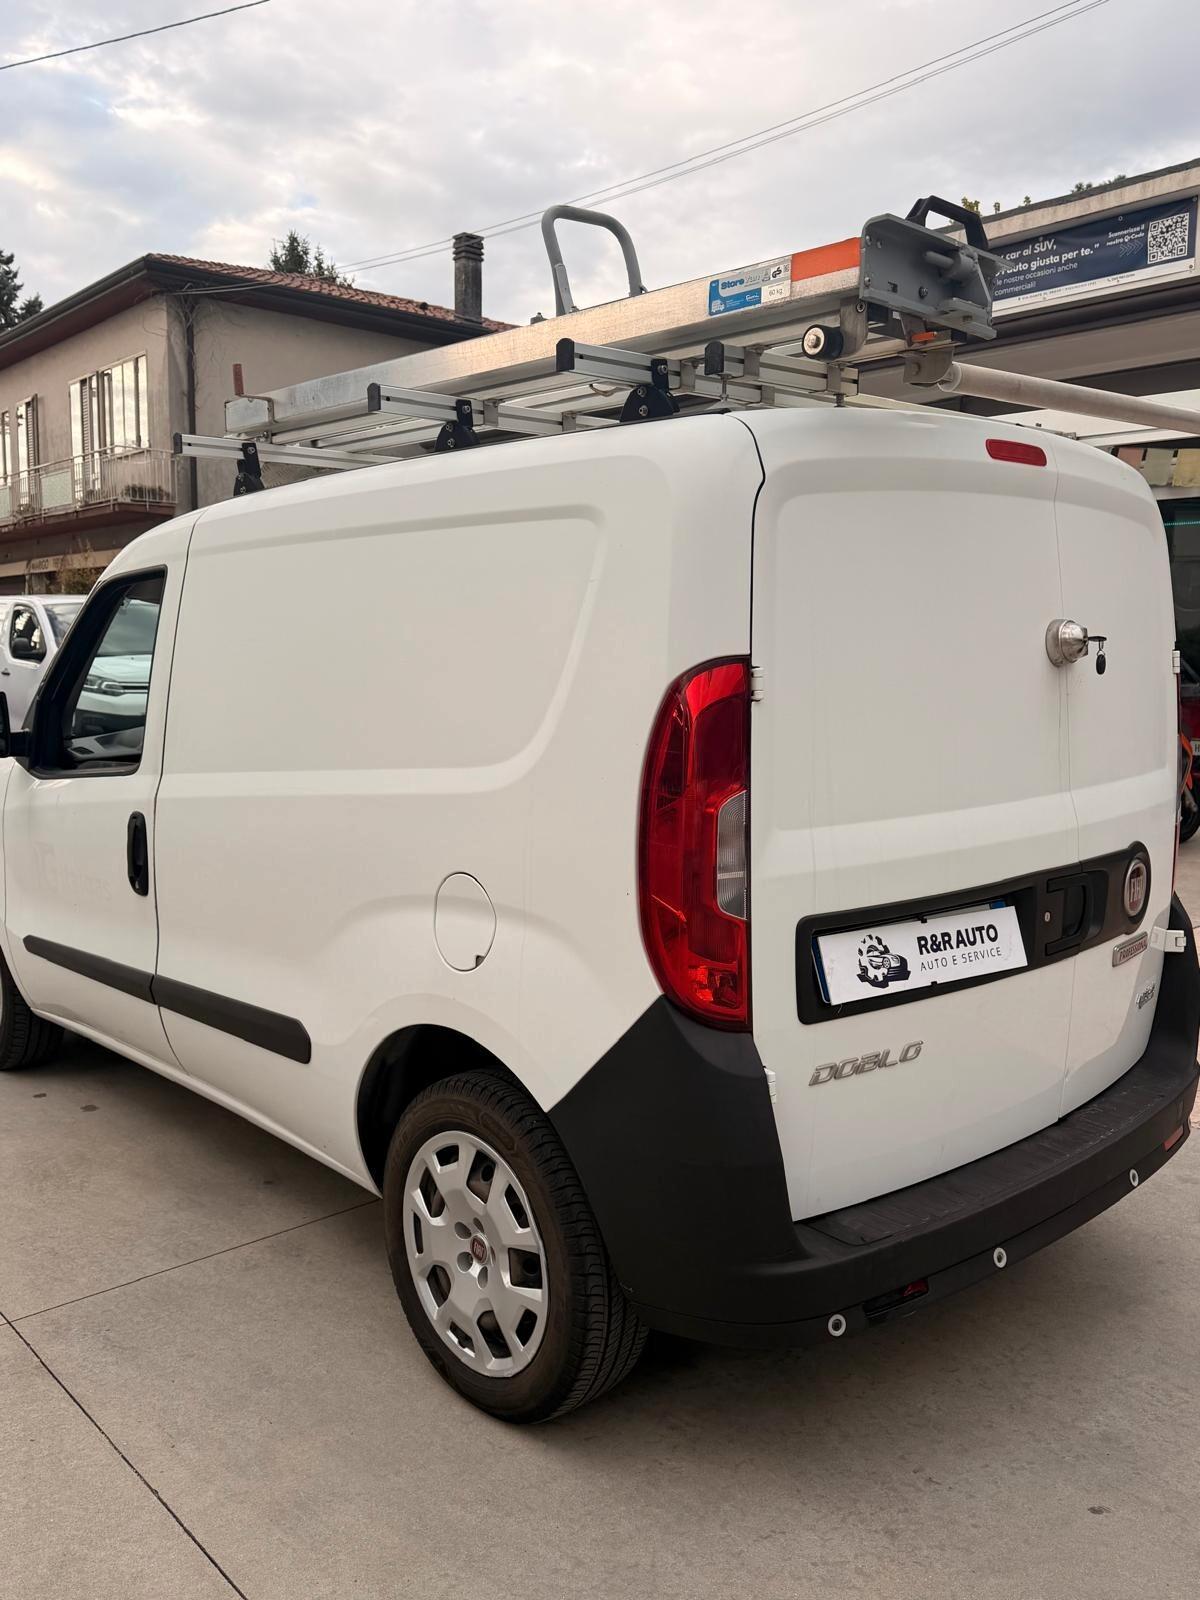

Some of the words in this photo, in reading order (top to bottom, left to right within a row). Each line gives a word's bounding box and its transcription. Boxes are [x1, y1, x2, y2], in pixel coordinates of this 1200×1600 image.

[1006, 250, 1021, 260] car
[1022, 245, 1032, 256] al
[1033, 239, 1057, 253] SUV,
[1030, 255, 1060, 271] giusta
[1061, 250, 1079, 263] per
[1003, 275, 1024, 285] nostre
[1025, 266, 1056, 280] occasioni
[1057, 262, 1078, 273] anche
[917, 931, 954, 956] R&R
[955, 923, 999, 949] AUTO
[920, 956, 948, 972] AUTO
[952, 955, 958, 966] E
[961, 946, 1002, 964] SERVICE
